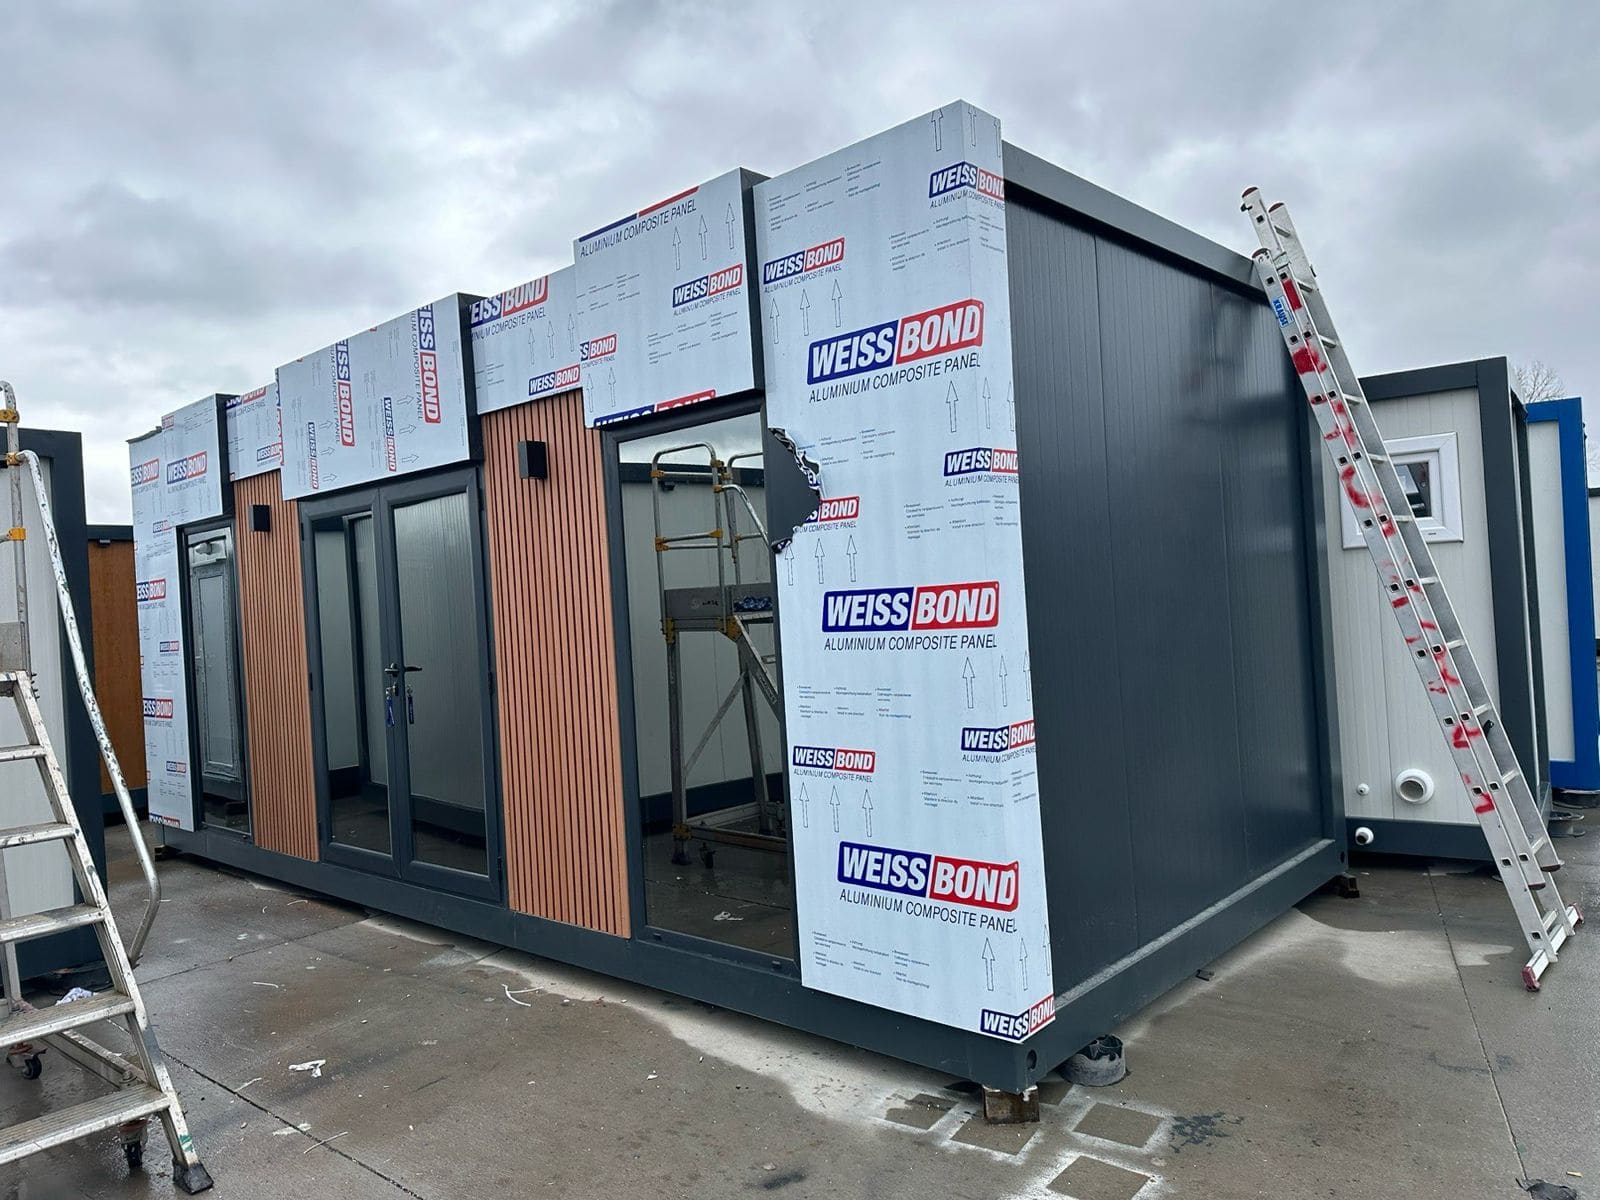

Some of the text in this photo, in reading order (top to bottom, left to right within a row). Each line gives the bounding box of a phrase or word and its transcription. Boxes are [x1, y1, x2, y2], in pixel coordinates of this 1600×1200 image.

[930, 189, 968, 209] ALUMINIUM
[580, 199, 697, 258] ALUMINIUM COMPOSITE PANEL
[764, 264, 842, 293] ALUMINIUM COMPOSITE PANEL
[492, 314, 526, 336] COMPOSITE
[527, 306, 546, 322] PANEL
[1272, 300, 1288, 325] KRAUSE
[411, 334, 420, 392] COMPOSITE
[809, 352, 981, 403] ALUMINIUM COMPOSITE PANEL
[944, 474, 983, 487] ALUMINIUM
[809, 522, 838, 532] COMPOSITE
[840, 520, 856, 528] PANEL
[824, 633, 997, 651] ALUMINIUM COMPOSITE PANEL
[962, 753, 1000, 764] ALUMINIUM
[793, 768, 872, 783] ALUMINIUM COMPOSITE PANEL
[840, 888, 1018, 934] ALUMINIUM COMPOSITE PANEL
